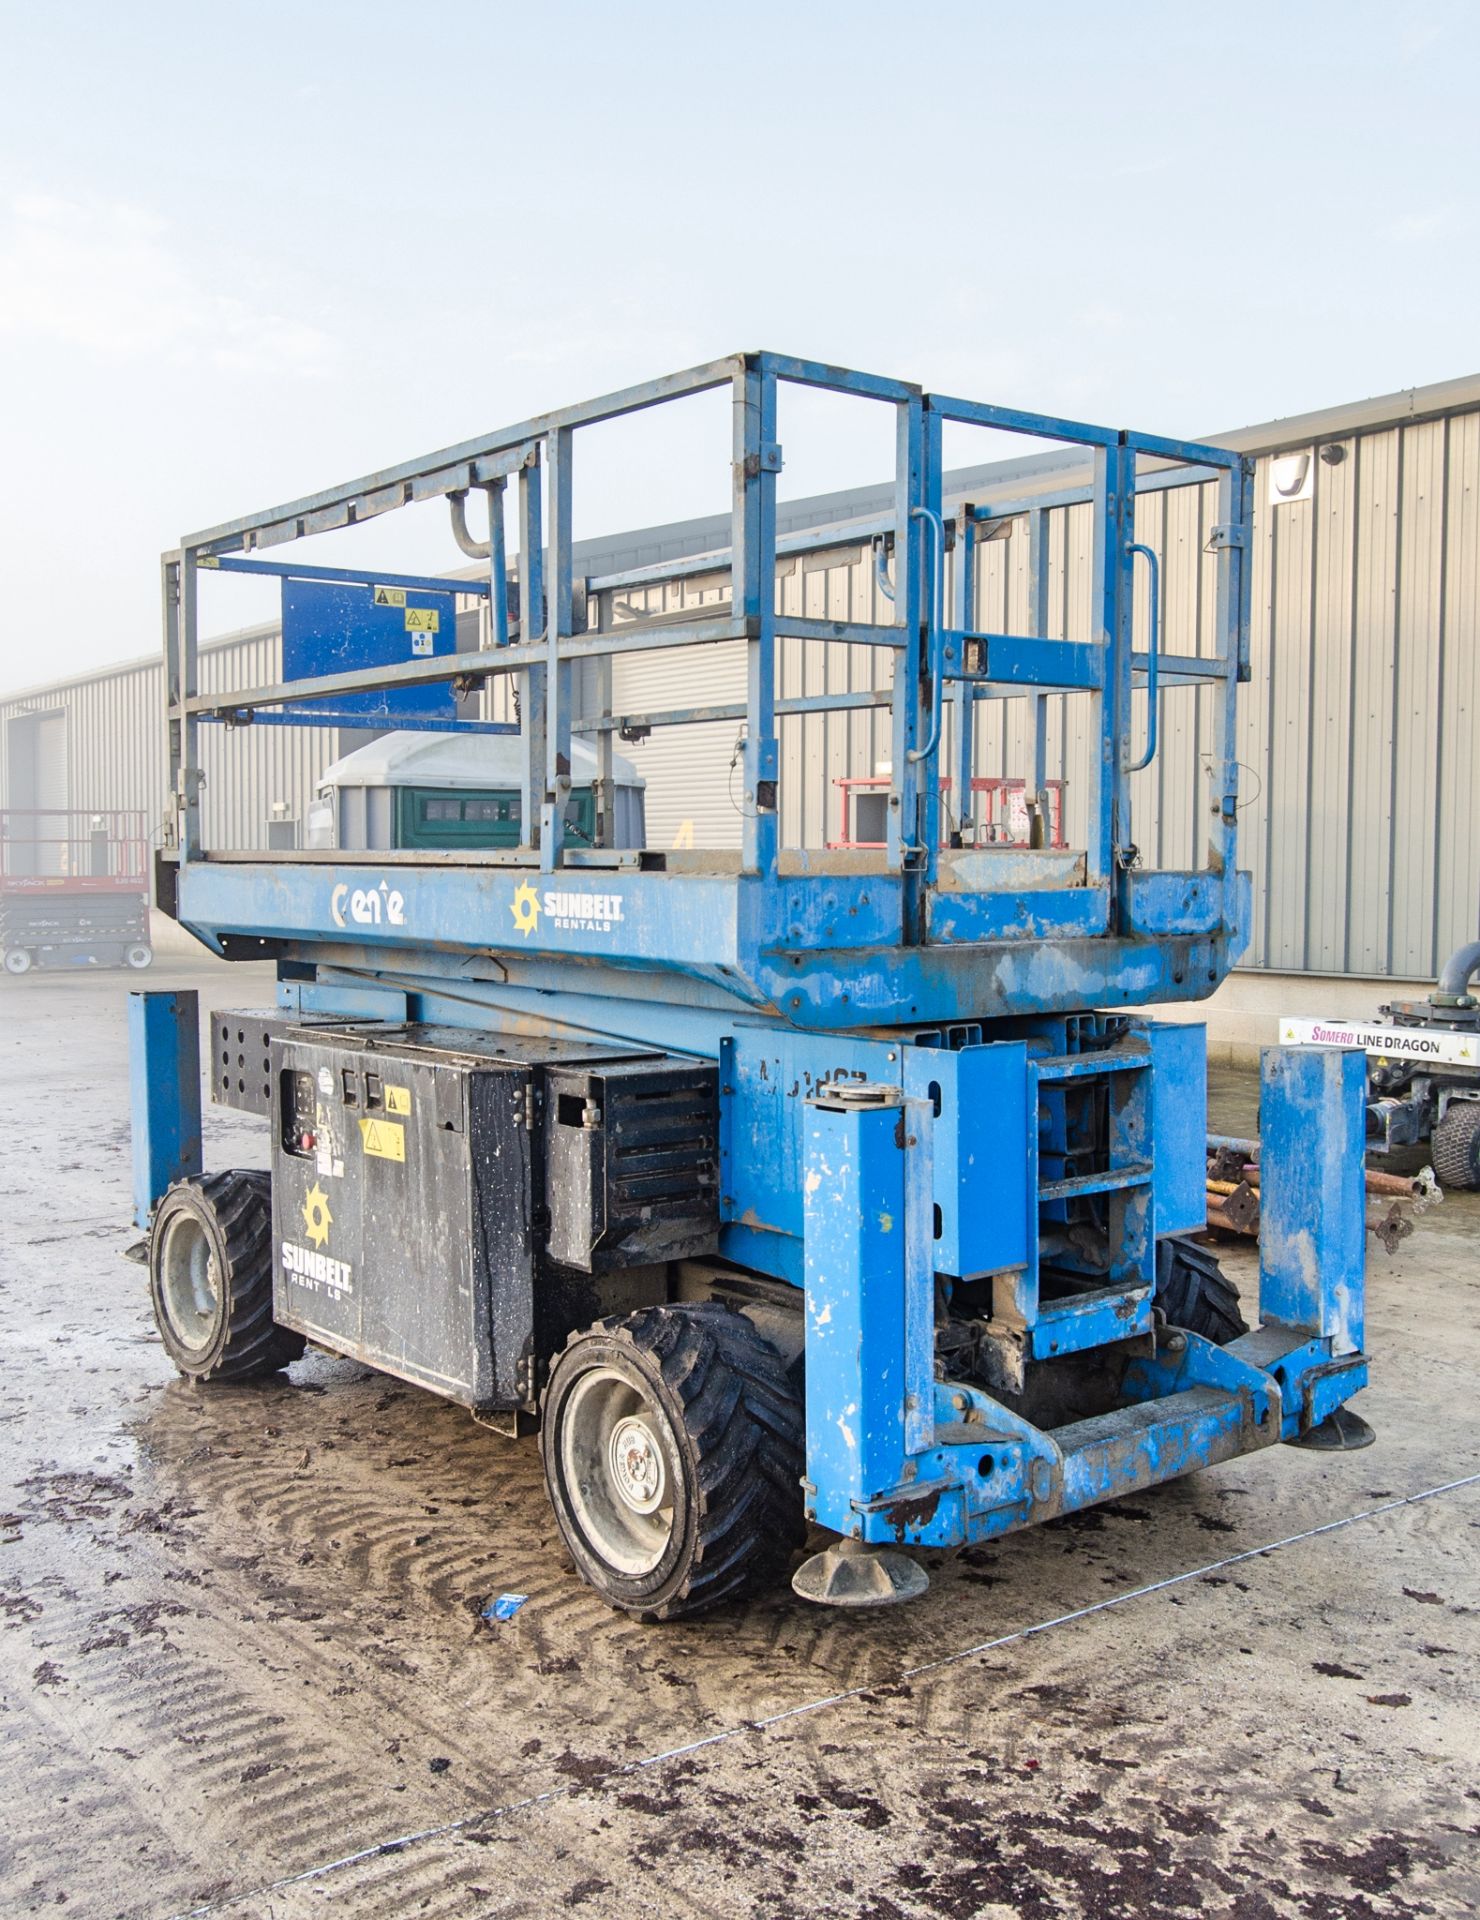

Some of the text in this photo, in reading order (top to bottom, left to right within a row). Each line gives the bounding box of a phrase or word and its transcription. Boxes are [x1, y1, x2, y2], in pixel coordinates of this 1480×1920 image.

[543, 891, 624, 922] SUNBELT
[554, 918, 611, 932] RENTALS
[1311, 1025, 1440, 1054] SOMERO LINE DRAGON
[281, 1241, 353, 1294] SUNBELT
[291, 1272, 341, 1301] RENTLS
